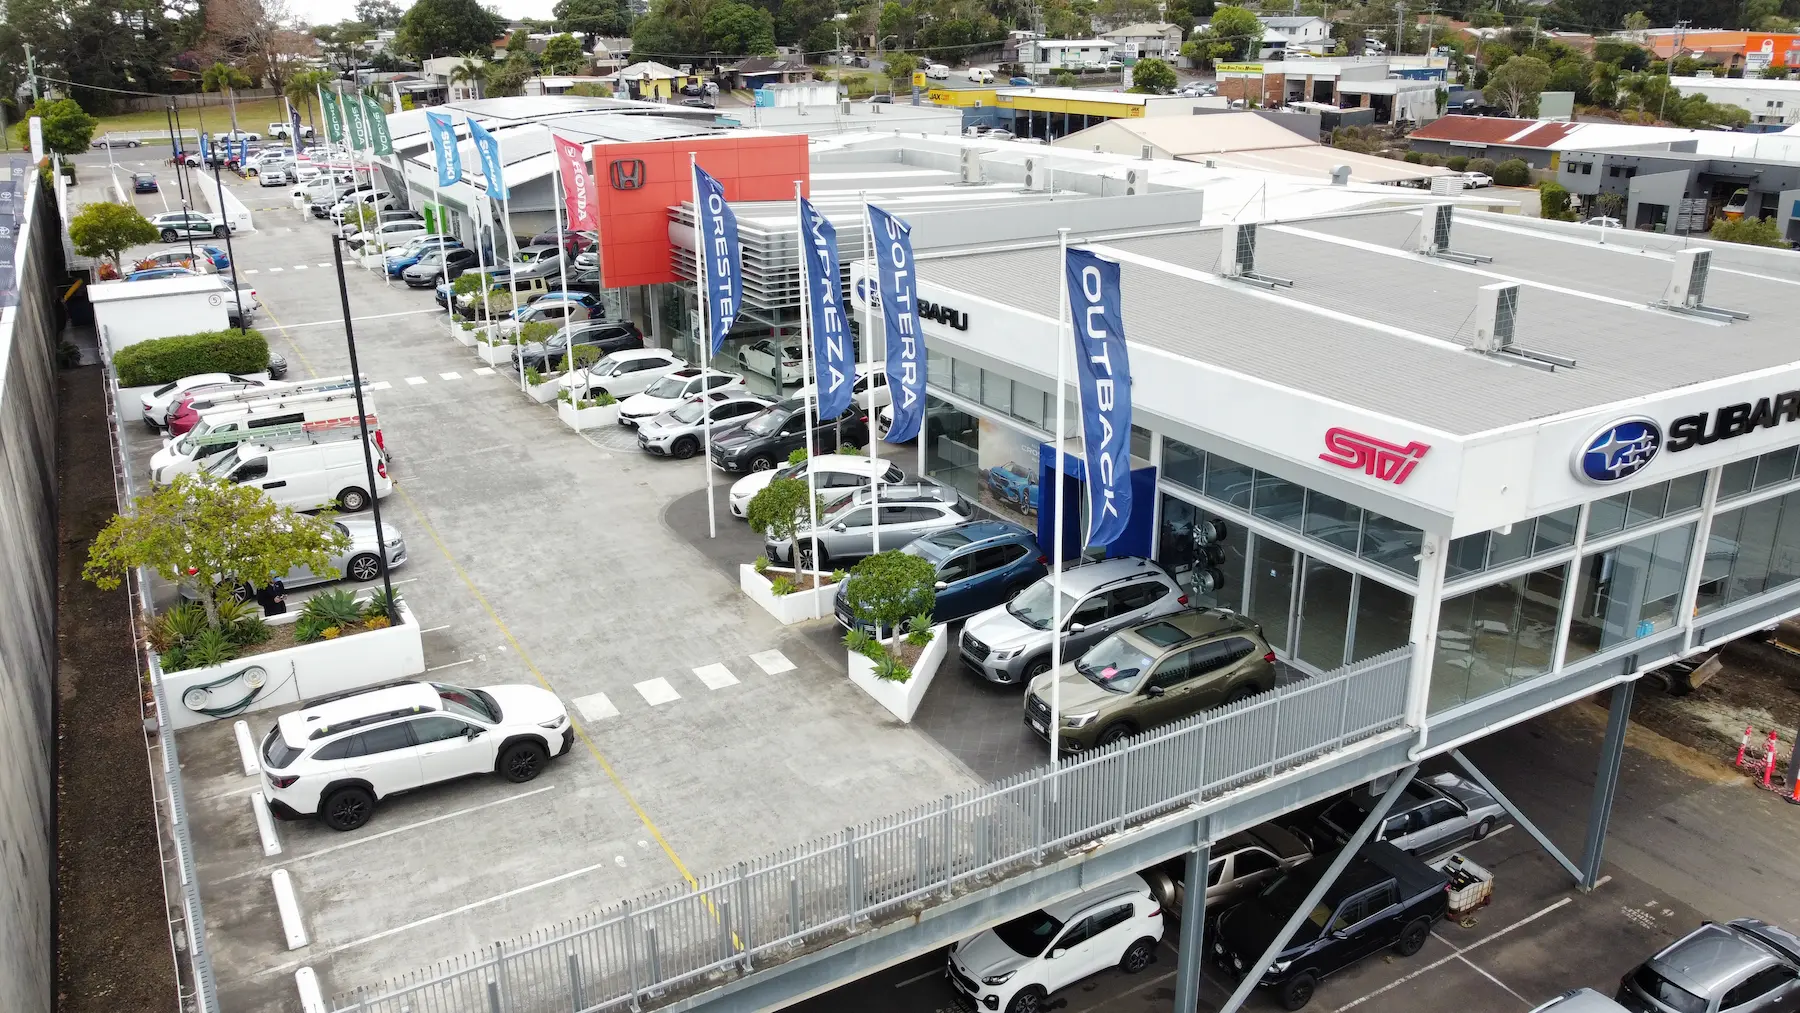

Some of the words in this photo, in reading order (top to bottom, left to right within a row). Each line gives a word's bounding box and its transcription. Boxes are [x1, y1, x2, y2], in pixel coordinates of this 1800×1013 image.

[351, 107, 365, 145] SKODA
[440, 131, 456, 180] SUZUKI
[571, 159, 588, 222] HONDA
[884, 215, 917, 410] SOLTERRA
[917, 298, 968, 331] BARU
[1081, 265, 1119, 519] OUTBACK
[1666, 390, 1800, 452] SUBAR
